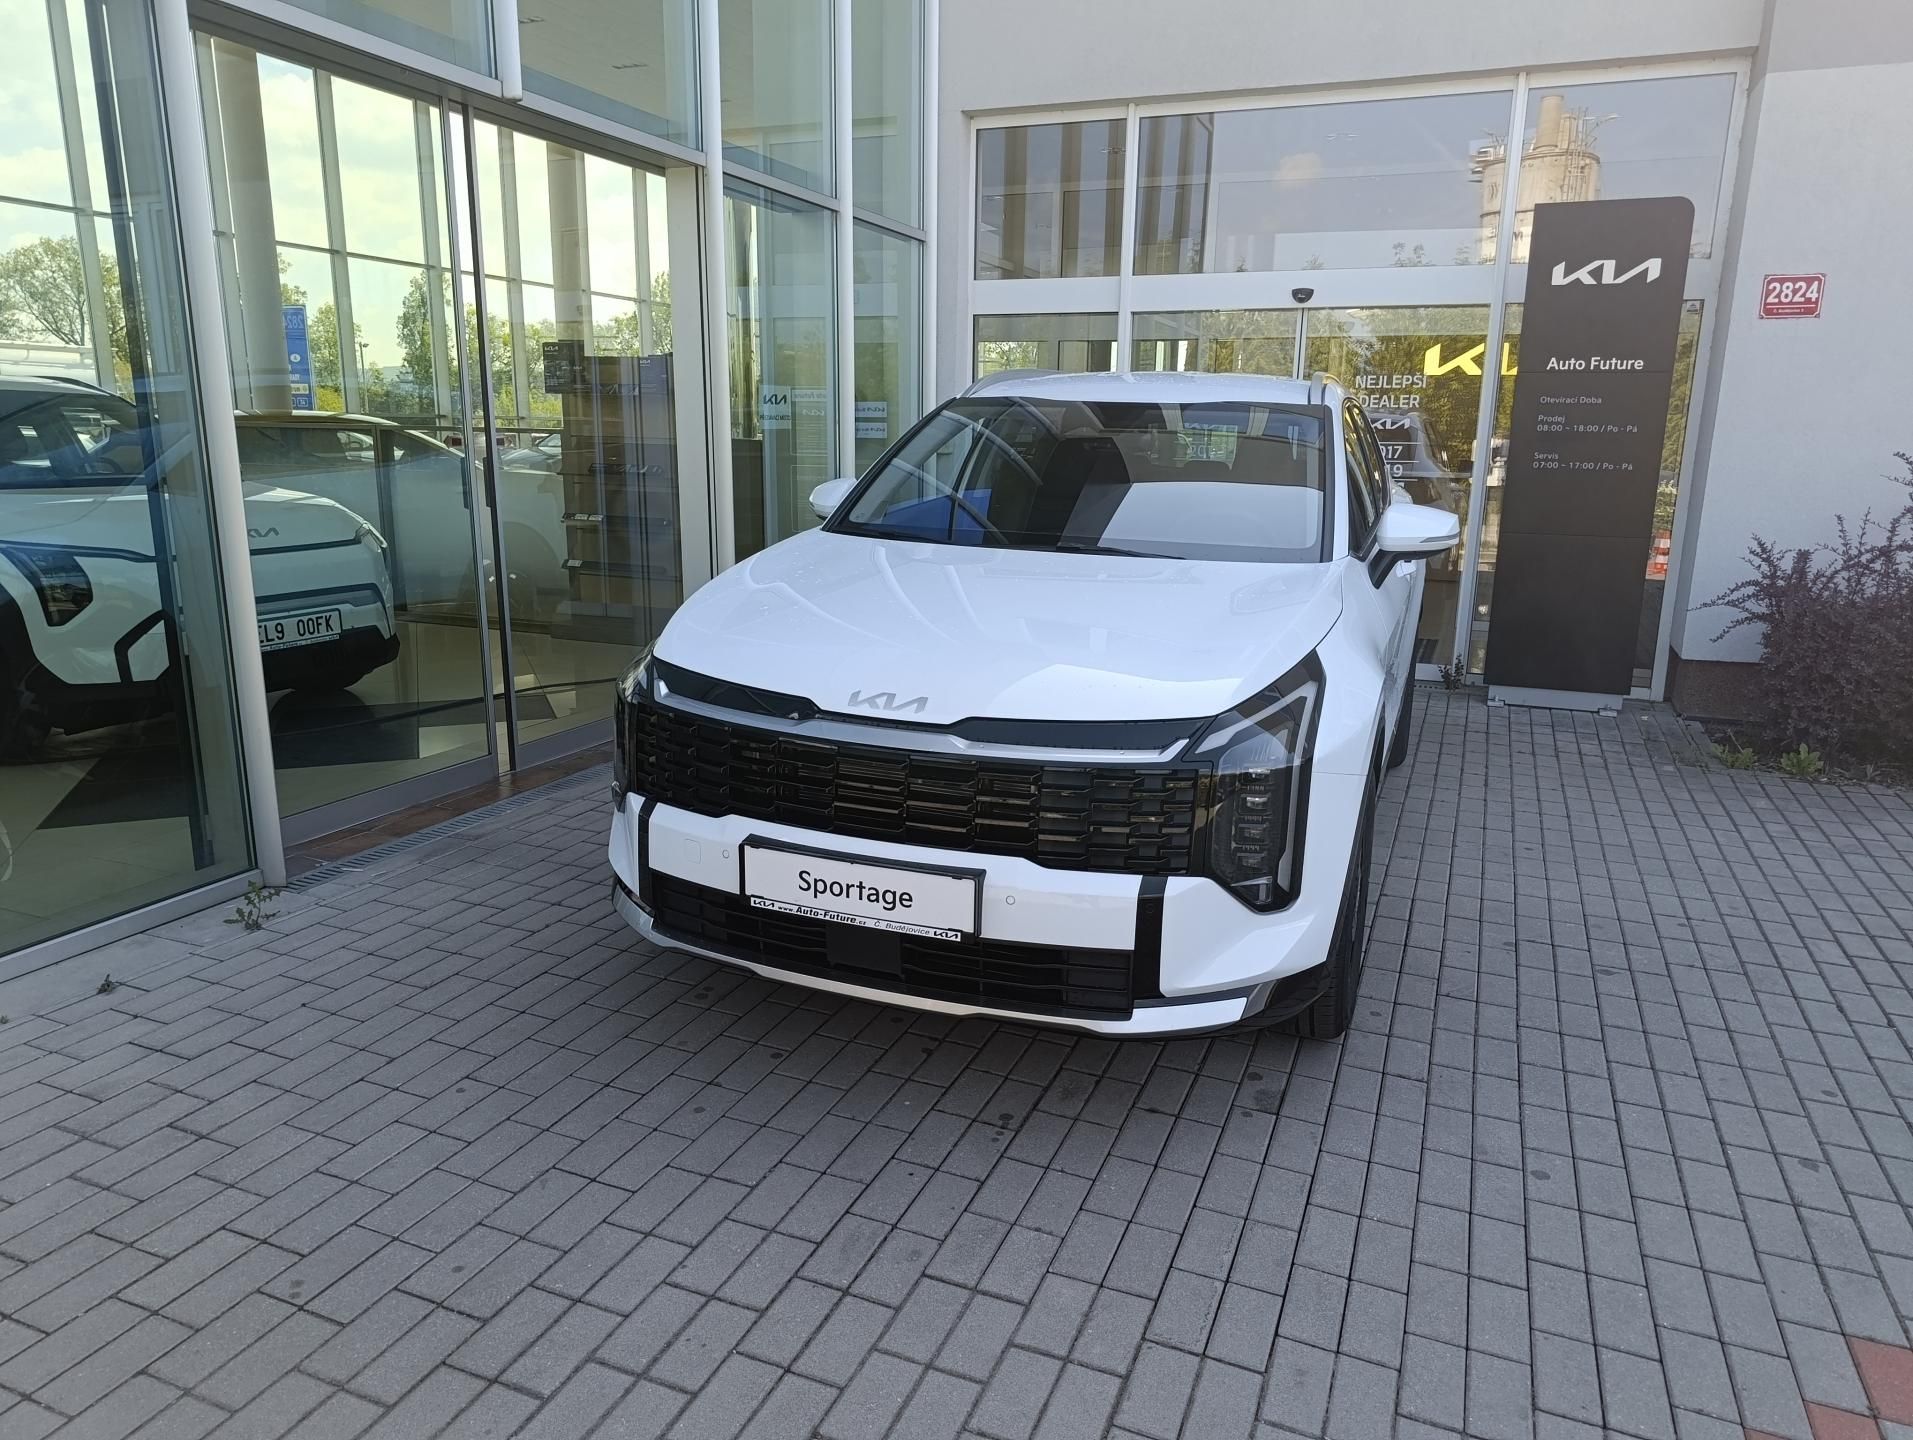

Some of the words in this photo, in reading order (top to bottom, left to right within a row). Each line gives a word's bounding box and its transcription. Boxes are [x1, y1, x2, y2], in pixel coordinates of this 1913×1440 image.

[1551, 257, 1662, 286] KIA
[1766, 280, 1819, 303] 2824
[1423, 342, 1519, 376] KI
[1546, 357, 1586, 370] Auto
[1590, 356, 1644, 370] Future
[1355, 372, 1427, 389] NEJLEPŠÍ
[1359, 394, 1420, 408] DEALER
[1580, 396, 1602, 404] Doba
[1537, 414, 1566, 424] Prodej
[1537, 424, 1563, 432] 08:00
[1573, 424, 1599, 432] 18:00
[1607, 425, 1619, 433] Po
[1626, 425, 1638, 433] Pá
[1534, 451, 1559, 460] Servis
[1533, 461, 1559, 469] 07:00
[1569, 462, 1594, 470] 17:00
[1602, 462, 1614, 470] Po
[1622, 462, 1633, 470] Pá
[847, 690, 929, 714] KIA
[798, 870, 914, 911] Sportage
[885, 922, 930, 936] Budějovice
[933, 930, 959, 940] KIA
